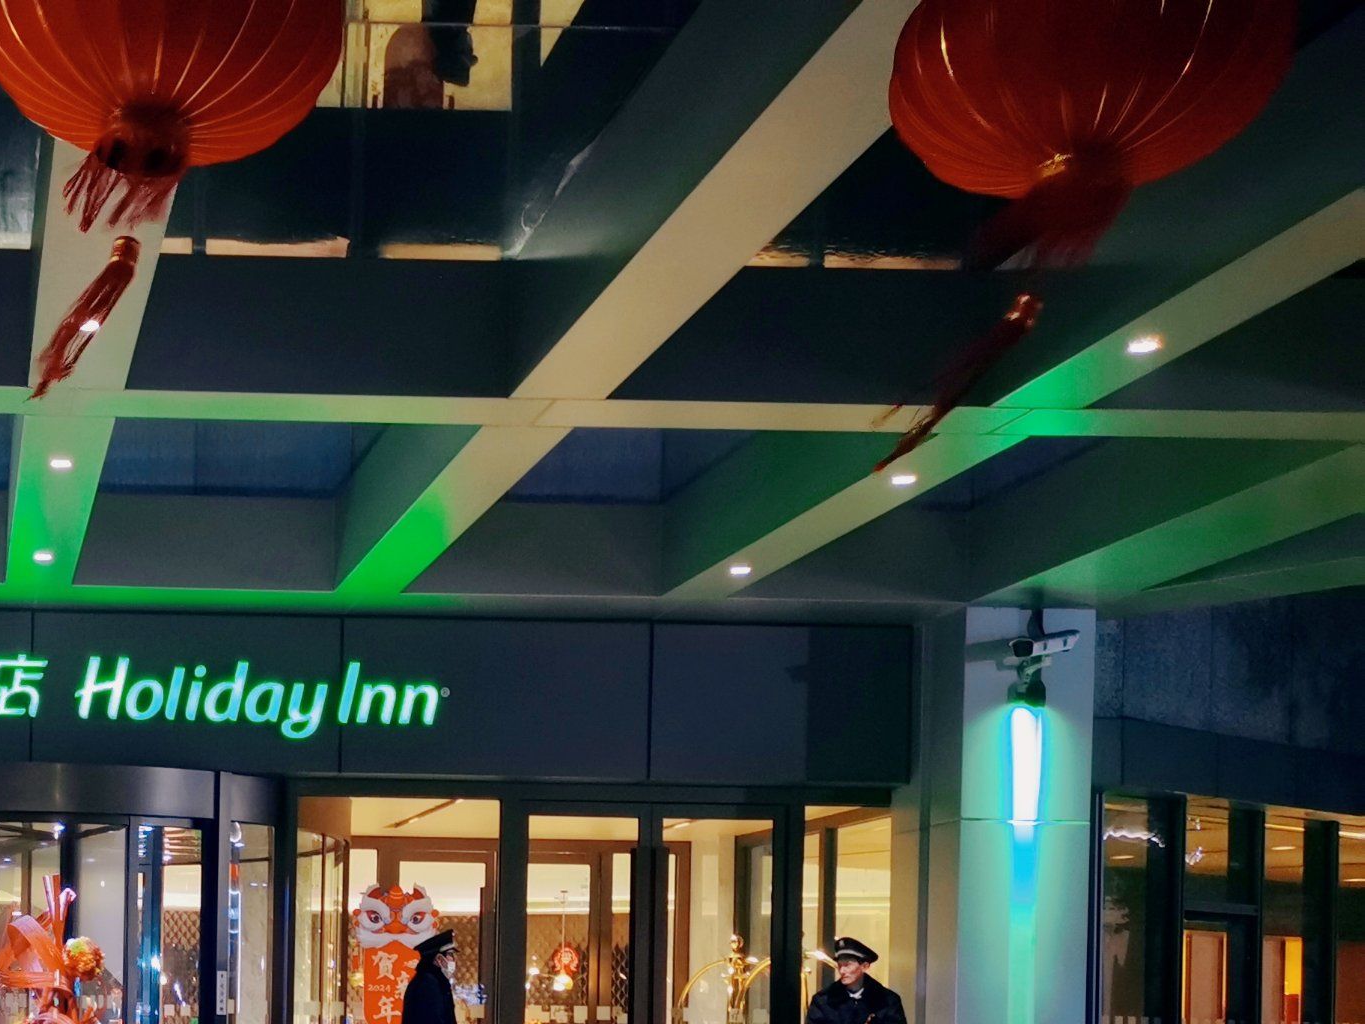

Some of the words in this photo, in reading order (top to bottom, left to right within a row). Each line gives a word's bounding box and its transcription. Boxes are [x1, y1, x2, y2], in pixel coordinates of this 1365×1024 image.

[74, 655, 329, 739] Holiday
[337, 661, 439, 726] Inn
[367, 984, 392, 993] 2024
